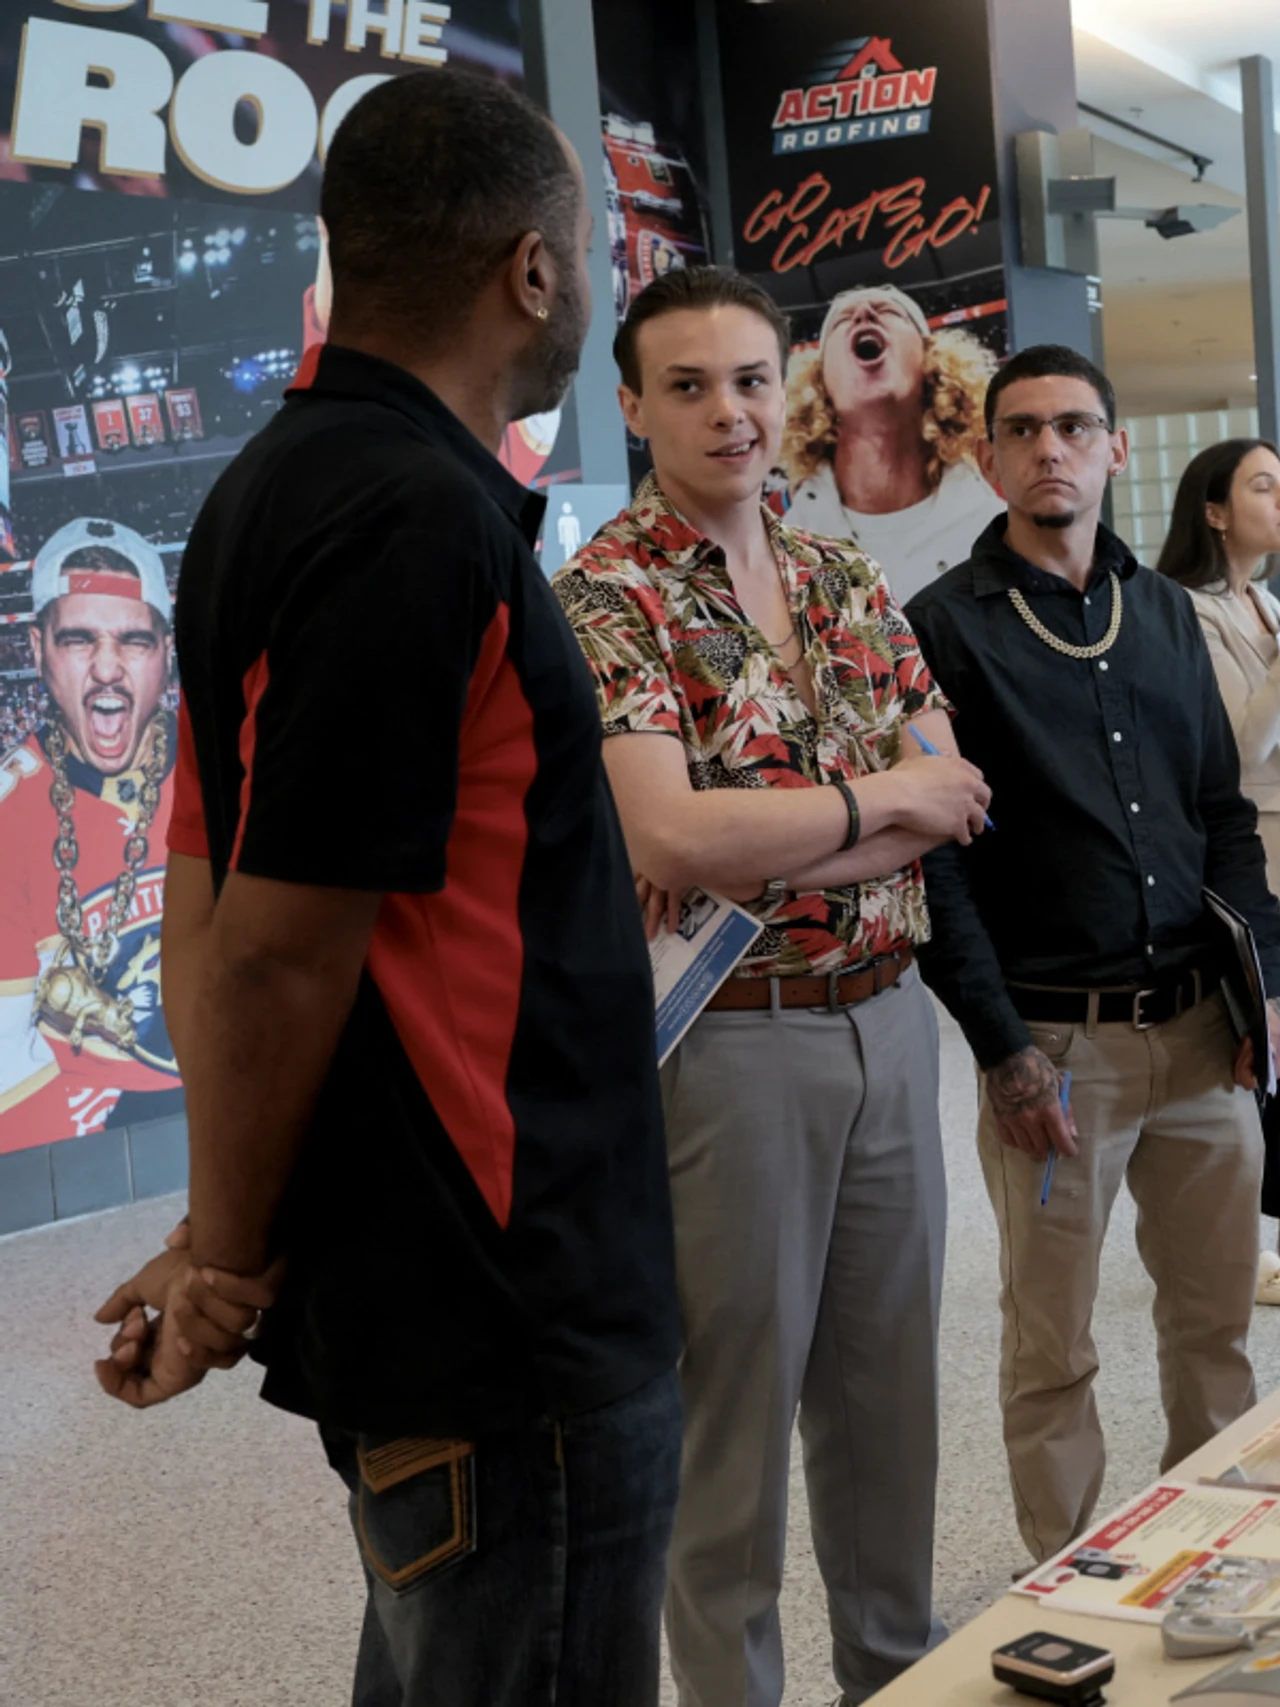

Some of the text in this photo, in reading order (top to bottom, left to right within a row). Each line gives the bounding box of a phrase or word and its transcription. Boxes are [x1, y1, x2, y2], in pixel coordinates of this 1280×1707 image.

[771, 67, 938, 129] ACTION
[781, 114, 923, 150] ROOFING
[743, 171, 991, 273] GO CATS GO!
